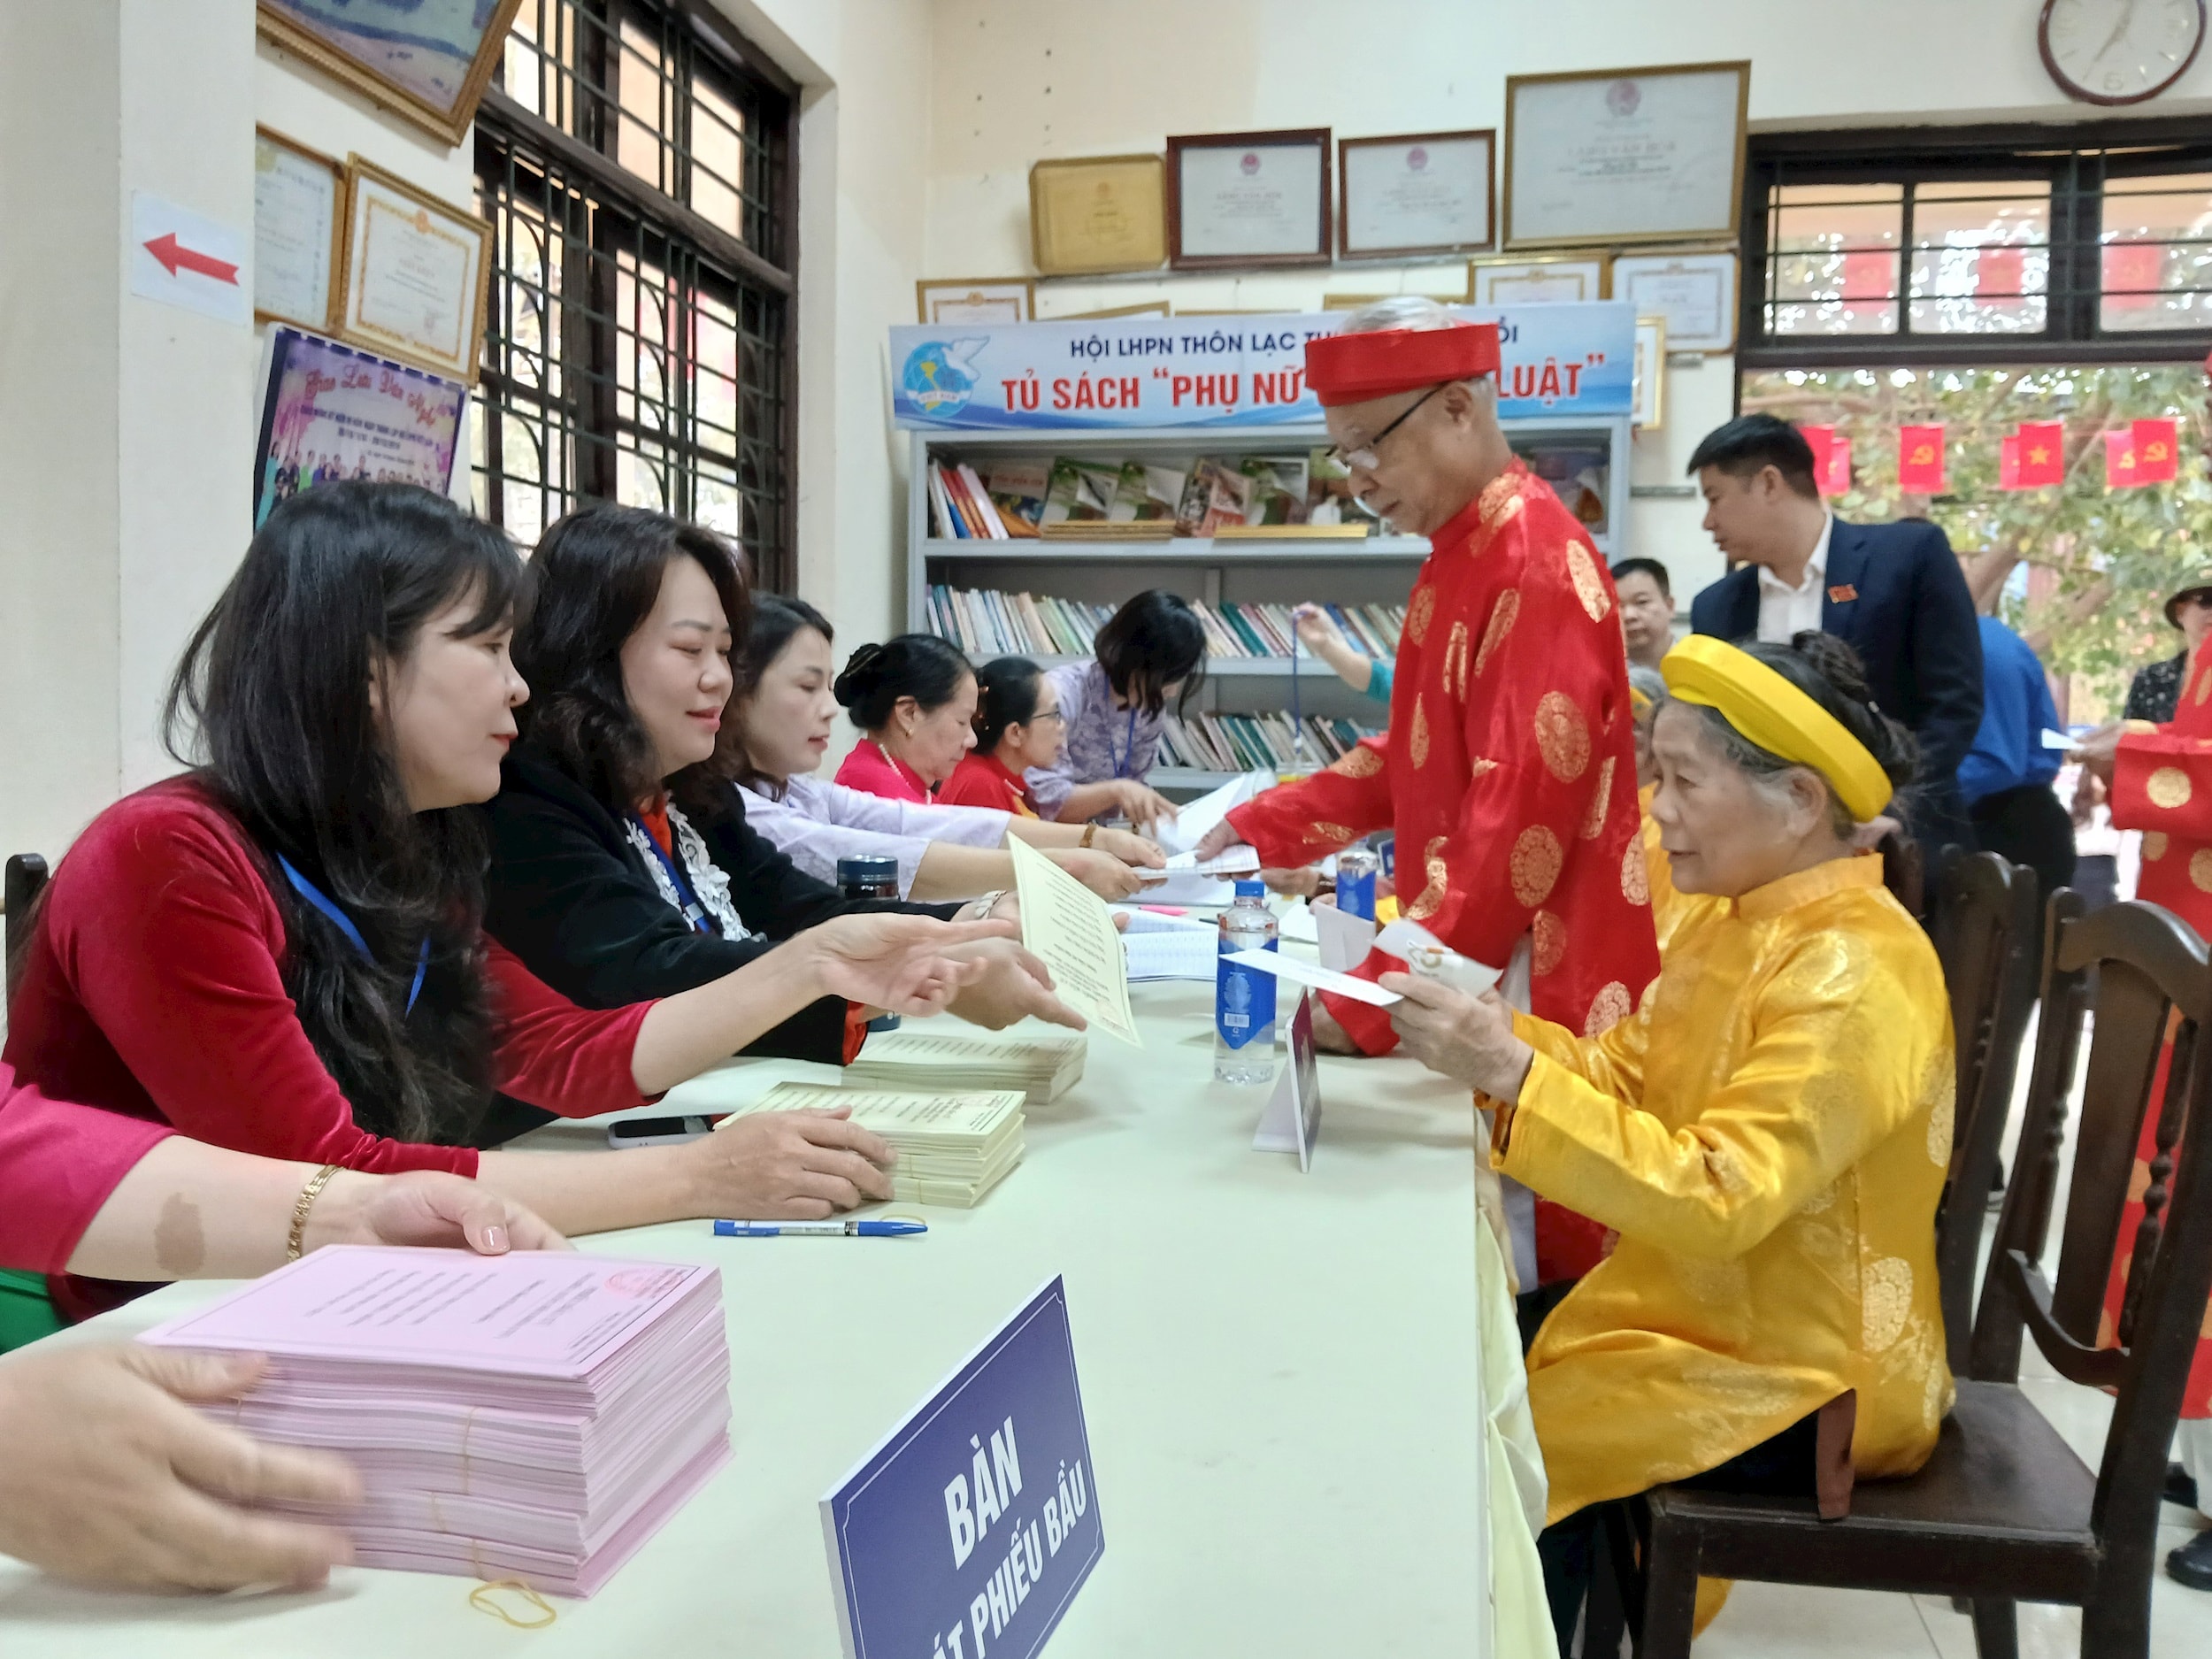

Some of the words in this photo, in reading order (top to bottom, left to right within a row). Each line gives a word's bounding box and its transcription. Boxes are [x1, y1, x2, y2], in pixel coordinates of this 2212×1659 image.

[1002, 368, 1040, 411] TỦ
[1053, 371, 1140, 410] SÁCH
[1253, 365, 1306, 404] NỮ
[1071, 334, 1110, 364] HỘI
[1118, 337, 1172, 356] LHPN
[1180, 330, 1242, 354] THÔN
[1252, 332, 1296, 357] LẠC
[943, 1415, 1023, 1571] BÀN
[970, 1517, 1044, 1659] PHIẾU
[1043, 1458, 1087, 1558] BẦU
